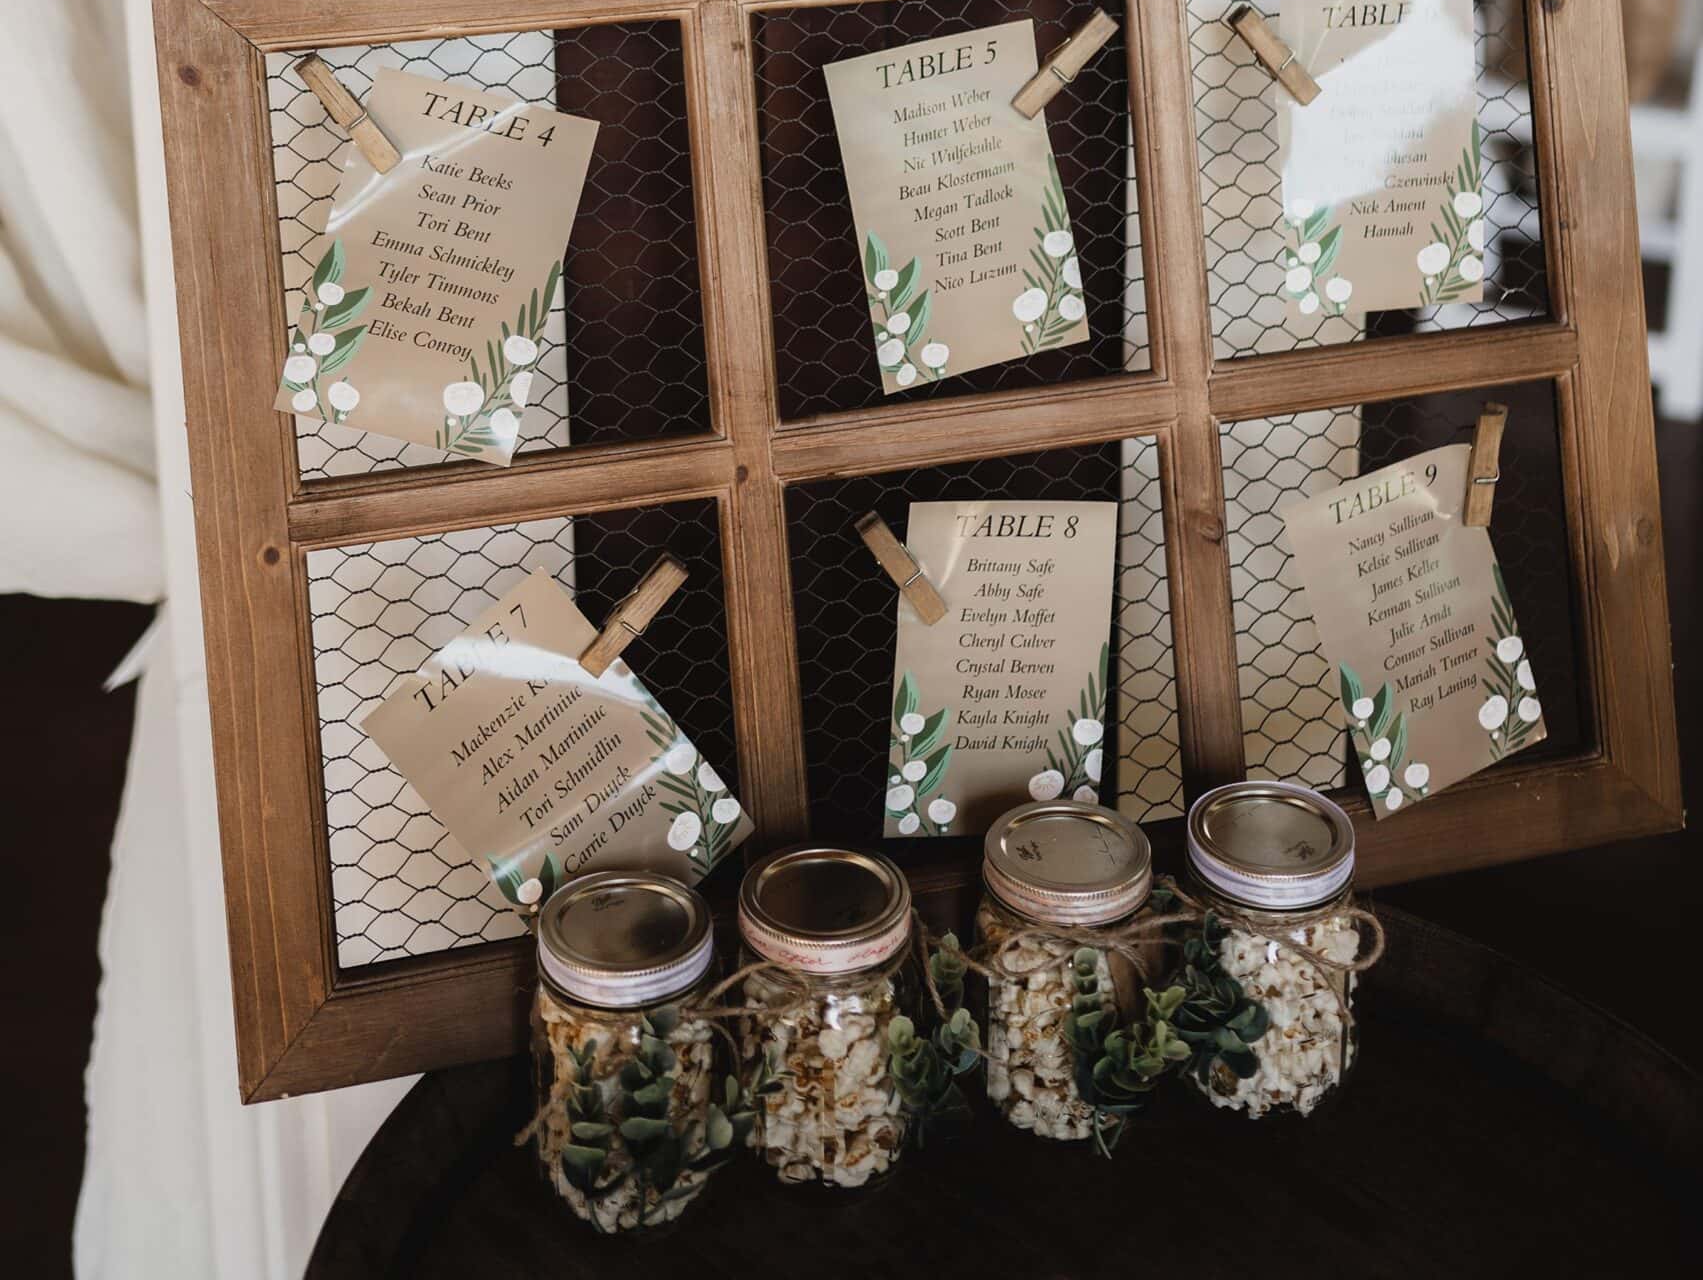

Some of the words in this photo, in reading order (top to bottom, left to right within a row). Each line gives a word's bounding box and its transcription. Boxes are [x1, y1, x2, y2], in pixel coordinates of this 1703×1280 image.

[876, 45, 972, 88] TABLE
[984, 40, 997, 64] 5
[422, 92, 529, 140] TABLE
[537, 126, 555, 147] 4
[893, 101, 945, 124] Madison
[951, 89, 990, 108] Weber
[904, 128, 946, 147] Hunter
[952, 114, 991, 133] Weber
[421, 154, 463, 178] Katie
[468, 167, 512, 190] Beeks
[904, 156, 924, 173] Nic
[931, 136, 1001, 165] Wulfekuhle
[899, 184, 930, 200] Beau
[937, 162, 1014, 191] Klostermann
[1384, 170, 1454, 188] Czerwinski
[418, 184, 456, 205] Sean
[461, 194, 501, 215] Prior
[914, 202, 957, 222] Megan
[963, 184, 1012, 208] Tadlock
[1350, 200, 1379, 215] Nick
[1384, 199, 1425, 213] Ament
[417, 211, 450, 232] Tori
[453, 221, 491, 243] Bent
[935, 225, 964, 242] Scott
[971, 216, 999, 233] Bent
[1363, 221, 1413, 238] Hannah
[370, 230, 424, 256] Emma
[428, 245, 514, 283] Schmickley
[936, 251, 967, 267] Tina
[973, 240, 1002, 258] Bent
[378, 260, 420, 284] Tyler
[427, 272, 499, 304] Timmons
[934, 276, 964, 293] Nico
[970, 263, 1016, 284] Luzum
[381, 292, 431, 318] Bekah
[436, 306, 474, 328] Bent
[367, 319, 407, 341] Elise
[413, 331, 472, 362] Conroy
[1328, 471, 1415, 524] TABLE
[1425, 464, 1437, 486] 9
[957, 515, 1054, 537] TABLE
[1064, 516, 1079, 538] 8
[1348, 531, 1384, 555] Nancy
[1388, 511, 1434, 536] Sullivan
[967, 558, 1021, 576] Brittany
[1026, 558, 1054, 577] Safe
[1357, 553, 1390, 578] Kelsie
[1394, 533, 1439, 560] Sullivan
[973, 583, 1011, 601] Abby
[1016, 584, 1044, 602] Safe
[1371, 575, 1403, 603] James
[1407, 560, 1438, 582] Keller
[509, 603, 526, 628] 7
[960, 608, 1007, 626] Evelyn
[1012, 608, 1054, 627] Moffet
[1367, 599, 1411, 626] Kennan
[1414, 576, 1460, 604] Sullivan
[958, 633, 1004, 652] Cheryl
[1010, 633, 1055, 648] Culver
[1389, 622, 1414, 648] Julie
[1420, 605, 1451, 629] Arndt
[1383, 644, 1425, 671] Connor
[1429, 623, 1474, 650] Sullivan
[956, 658, 1004, 677] Crystal
[1010, 659, 1054, 673] Berven
[1395, 666, 1436, 693] Mariah
[1439, 647, 1477, 672] Turner
[962, 684, 999, 702] Ryan
[1409, 694, 1433, 712] Ray
[1437, 673, 1477, 700] Laning
[450, 695, 526, 766] Mackenzie
[482, 748, 514, 785] Alex
[513, 685, 582, 750] Martiniuc
[957, 709, 997, 727] Kayla
[1003, 710, 1049, 728] Knight
[498, 769, 539, 814] Aidan
[538, 705, 605, 770] Martiniuc
[954, 735, 997, 750] David
[1001, 735, 1048, 752] Knight
[519, 793, 553, 828] Tori
[554, 734, 621, 799] Schmidlin
[550, 813, 583, 846] Sam
[583, 765, 632, 815] Duyck
[564, 831, 608, 879] Carrie
[608, 784, 656, 833] Duyck
